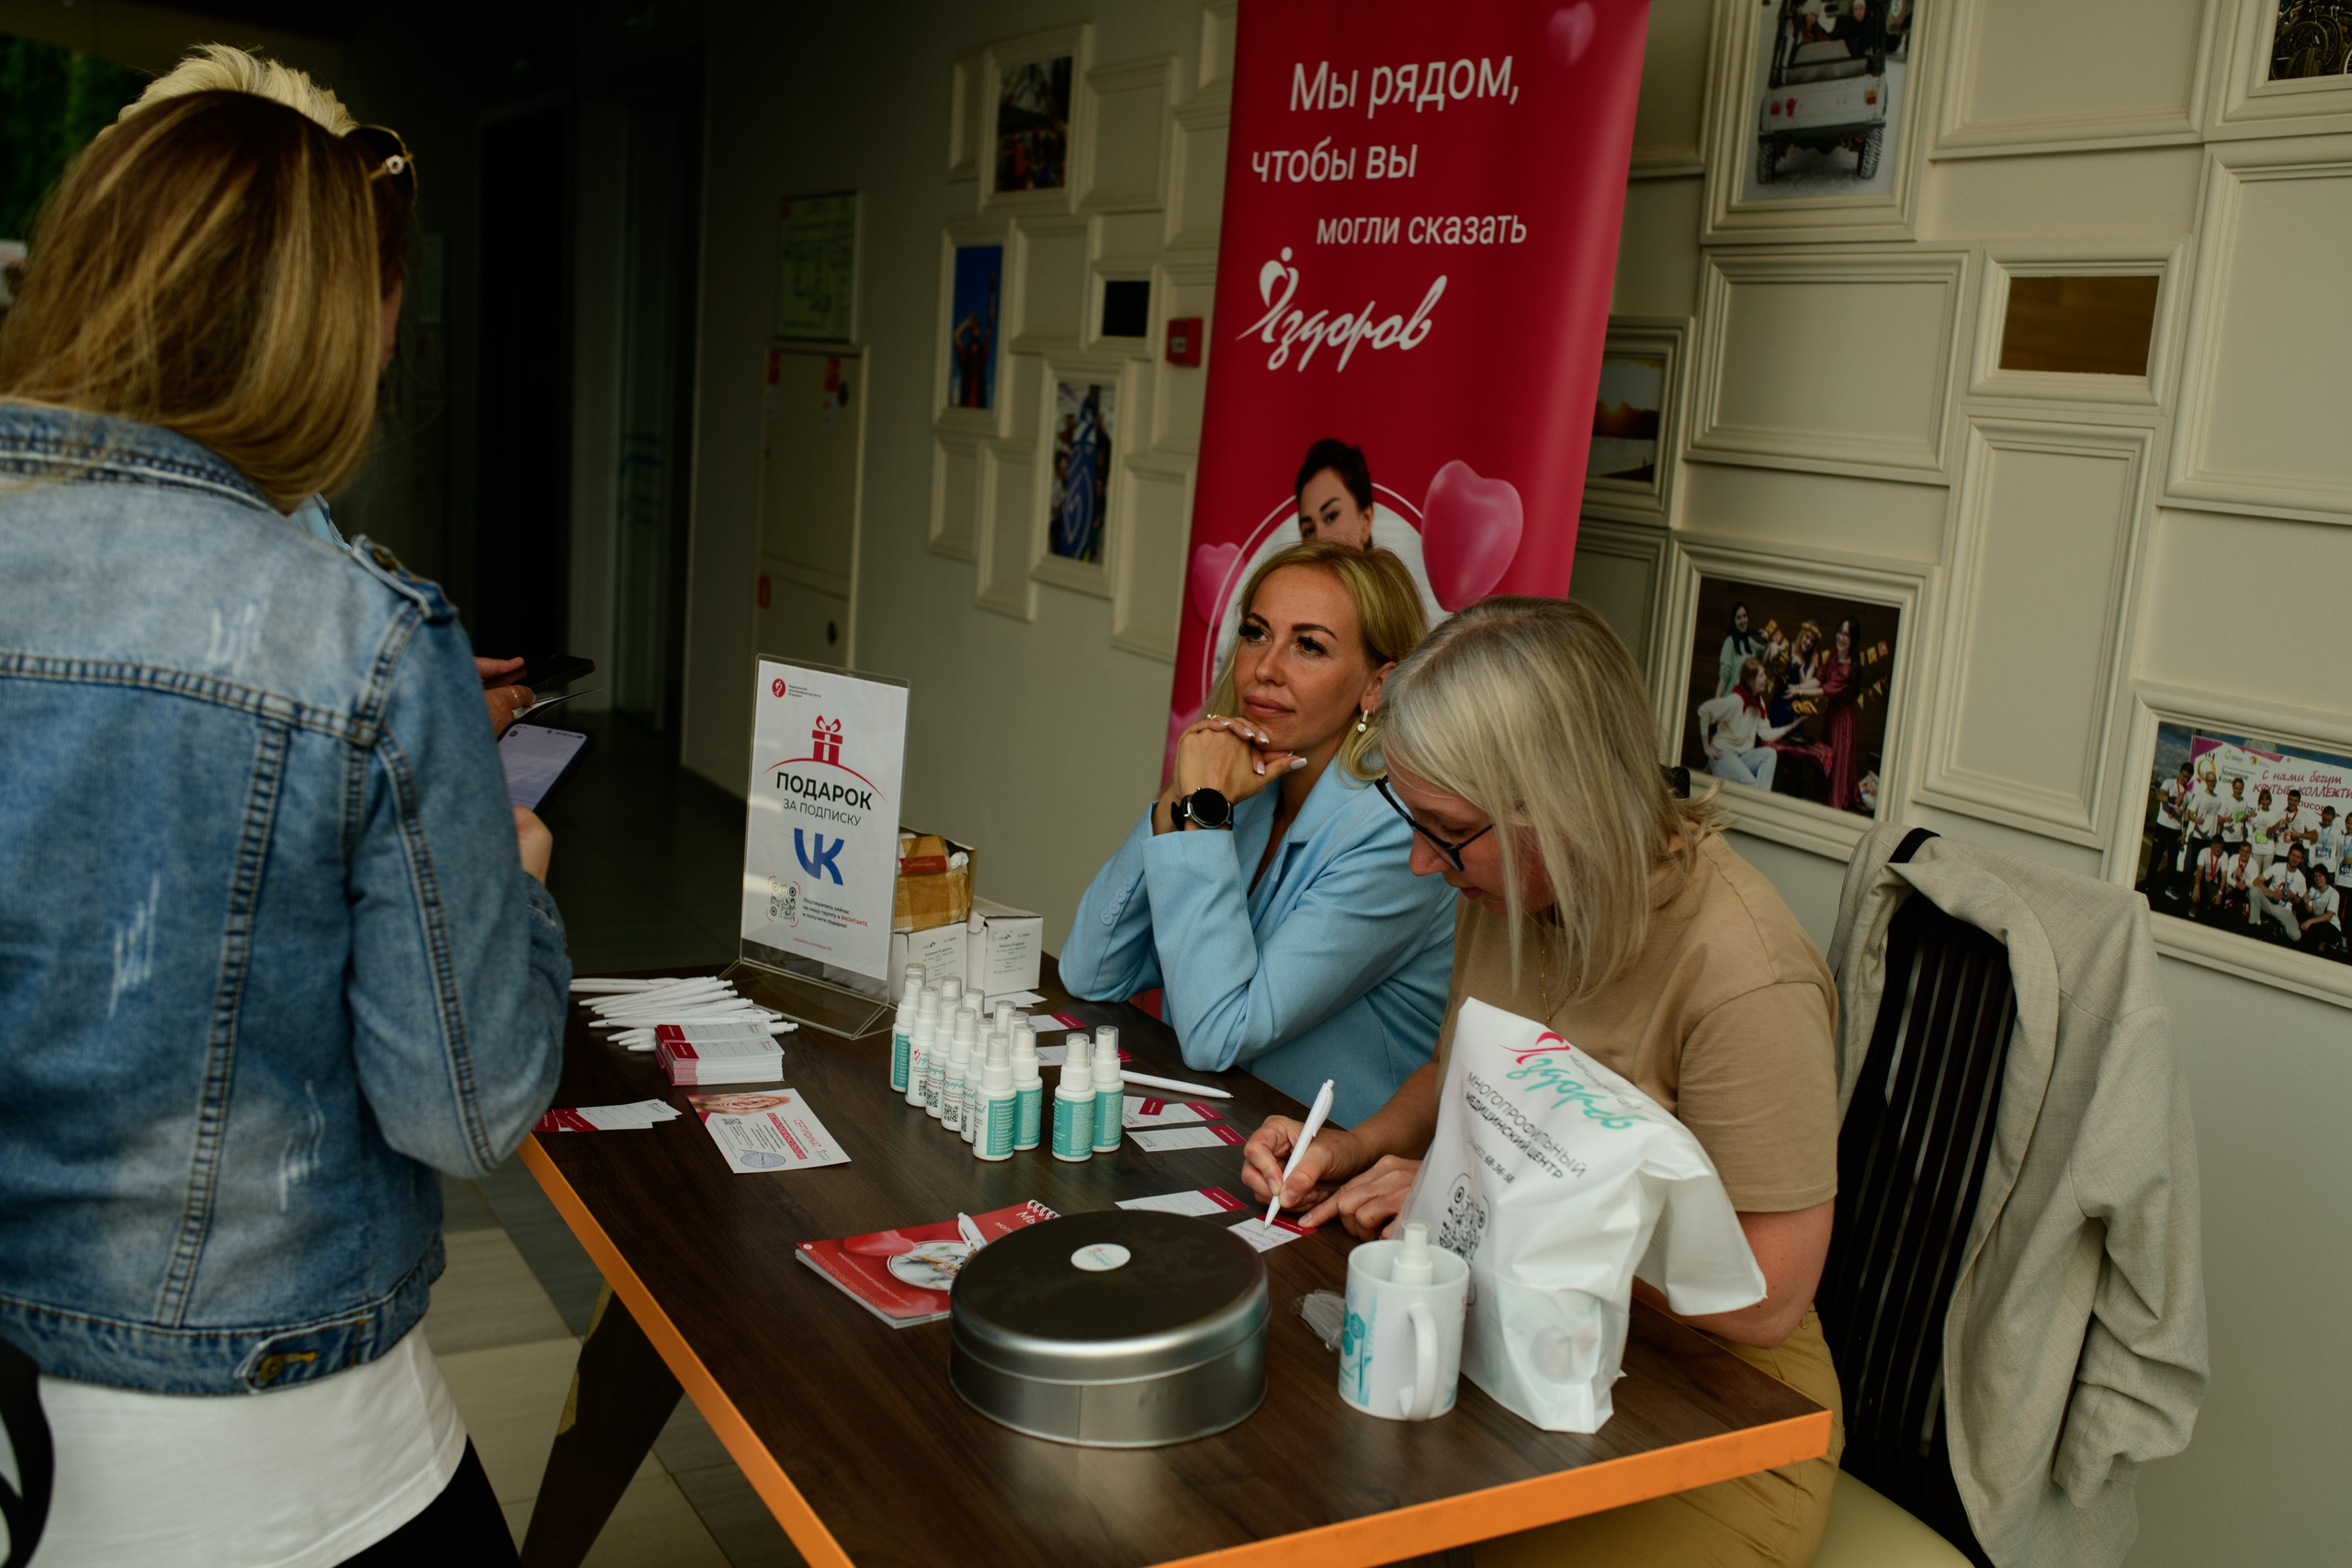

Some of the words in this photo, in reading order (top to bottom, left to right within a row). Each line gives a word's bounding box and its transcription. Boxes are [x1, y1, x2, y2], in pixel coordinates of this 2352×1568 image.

[1290, 62, 1358, 111] Мы
[1368, 56, 1519, 118] рядом,
[1251, 136, 1356, 183] чтобы
[1365, 144, 1418, 179] вы
[1317, 217, 1400, 244] могли
[1408, 215, 1527, 244] сказать
[776, 772, 872, 810] ПОДАРОК
[2262, 769, 2268, 781] С
[2273, 773, 2304, 783] нами
[2309, 770, 2342, 788] бегут
[784, 798, 797, 811] ЗА
[800, 802, 861, 826] ПОДПИСКУ
[841, 915, 868, 927] ВКОНТАКТЕ
[1465, 1091, 1531, 1152] МЕДИЦИНСКИЙ
[1526, 1145, 1564, 1179] ЦЕНТР
[1466, 1071, 1587, 1179] МНОГОПРОФИЛЬНЫЙ
